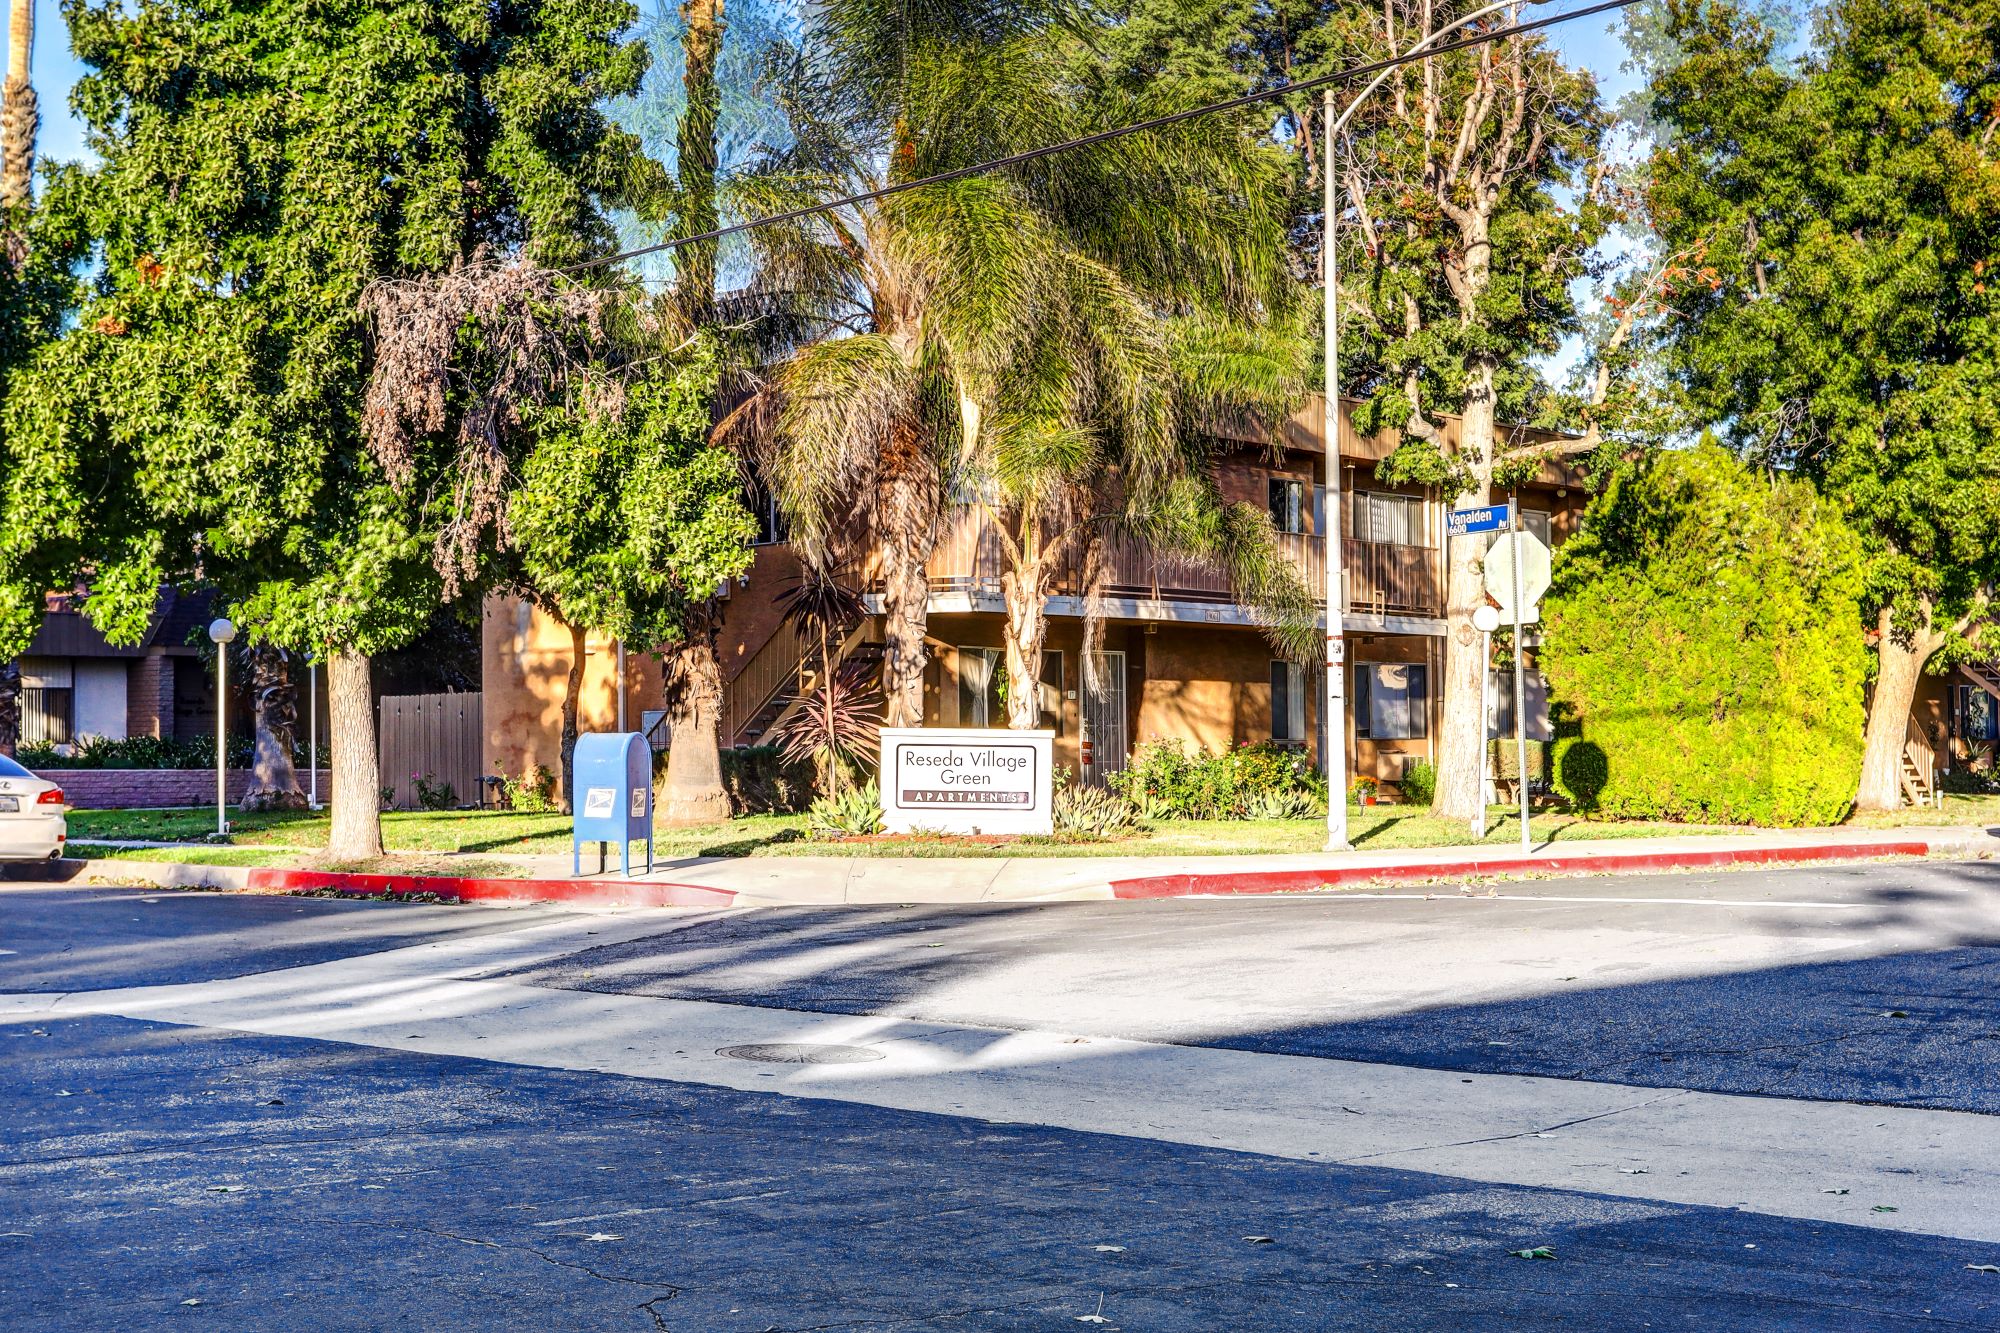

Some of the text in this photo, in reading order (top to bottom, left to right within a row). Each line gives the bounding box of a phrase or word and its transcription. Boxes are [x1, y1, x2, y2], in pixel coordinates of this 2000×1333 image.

[1449, 511, 1492, 525] Vanalden
[1449, 519, 1507, 534] 6600 Av
[906, 750, 1027, 773] Reseda Village
[940, 769, 991, 785] Green
[914, 791, 1018, 803] APARTMENTS
